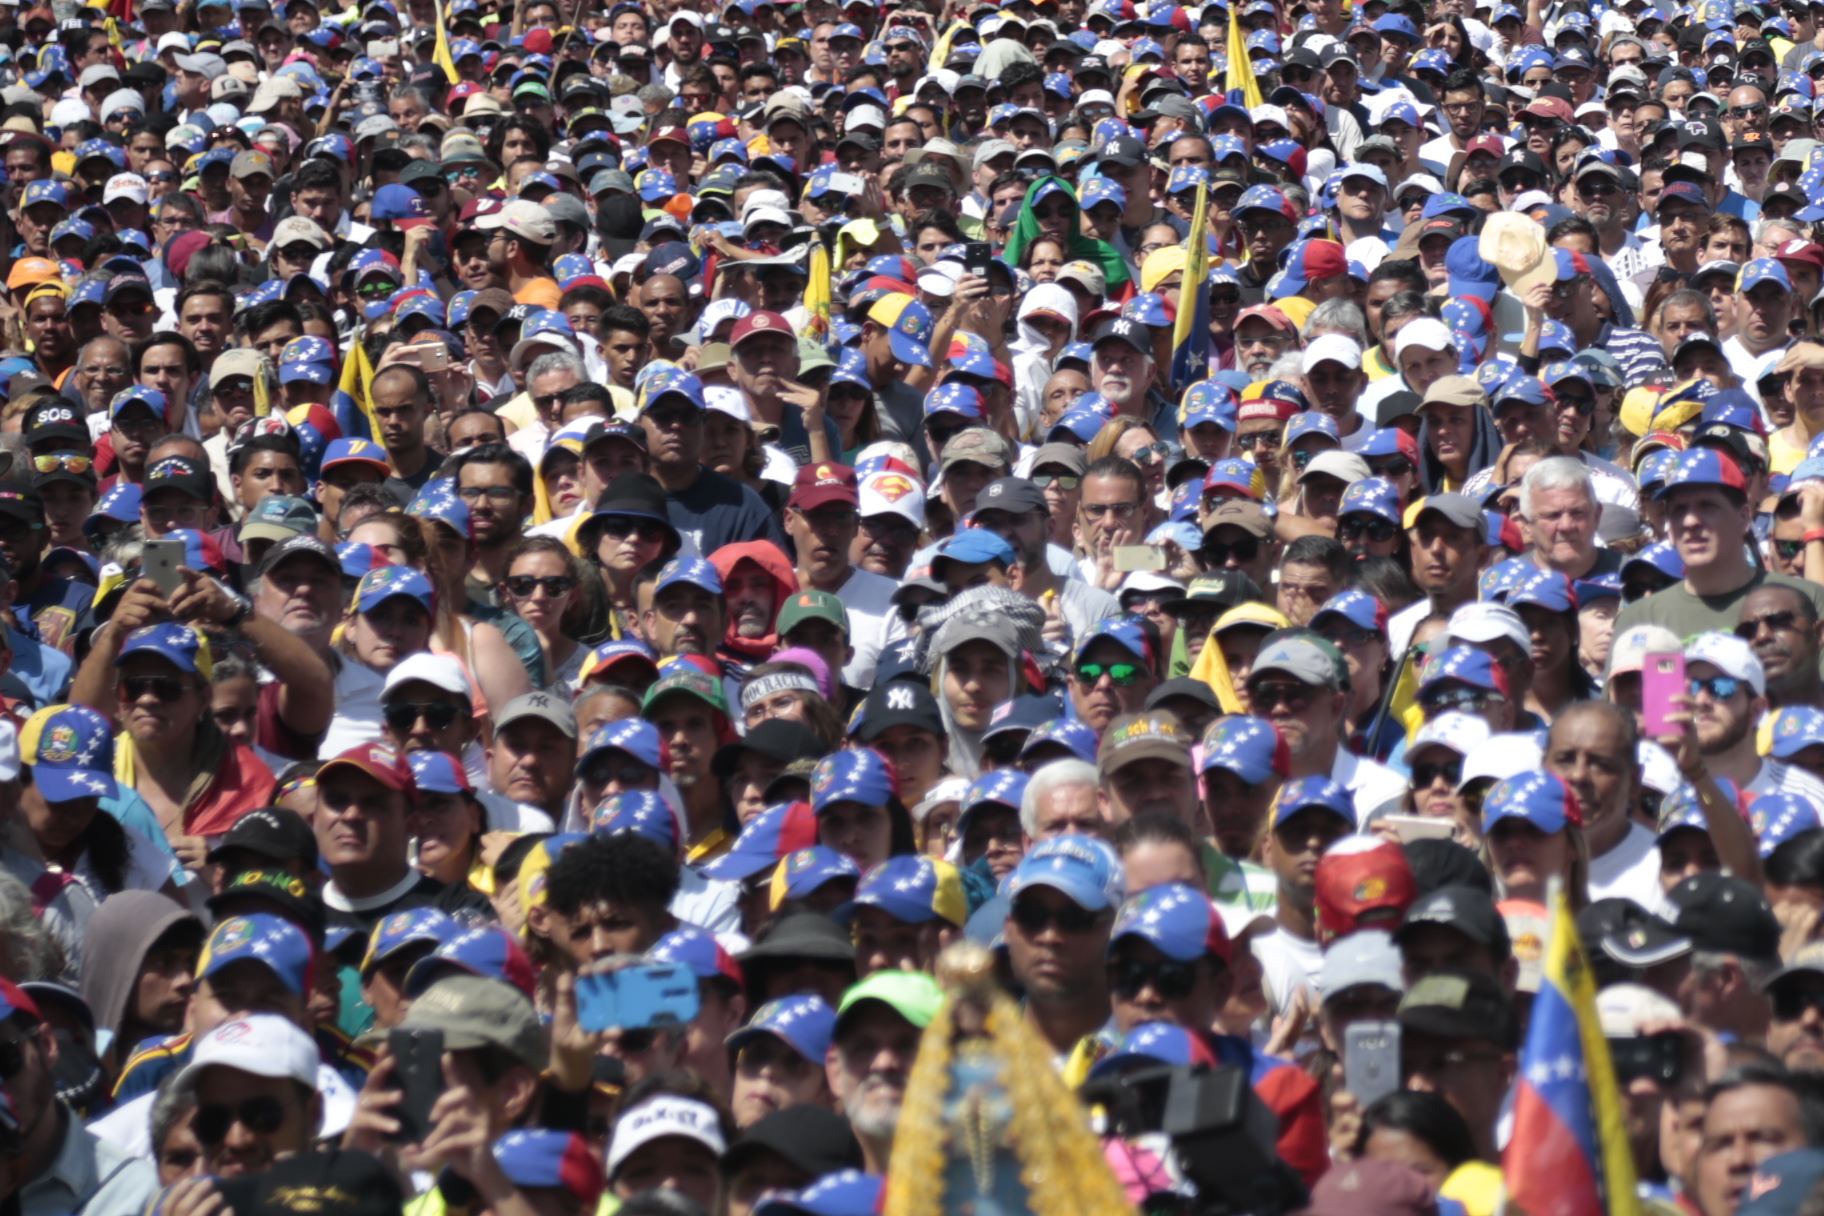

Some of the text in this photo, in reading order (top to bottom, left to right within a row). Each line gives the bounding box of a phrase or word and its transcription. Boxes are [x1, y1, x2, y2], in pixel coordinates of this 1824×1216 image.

[1105, 141, 1121, 156] NY
[1112, 319, 1132, 336] NY
[39, 408, 74, 423] SOS
[887, 687, 914, 710] NY
